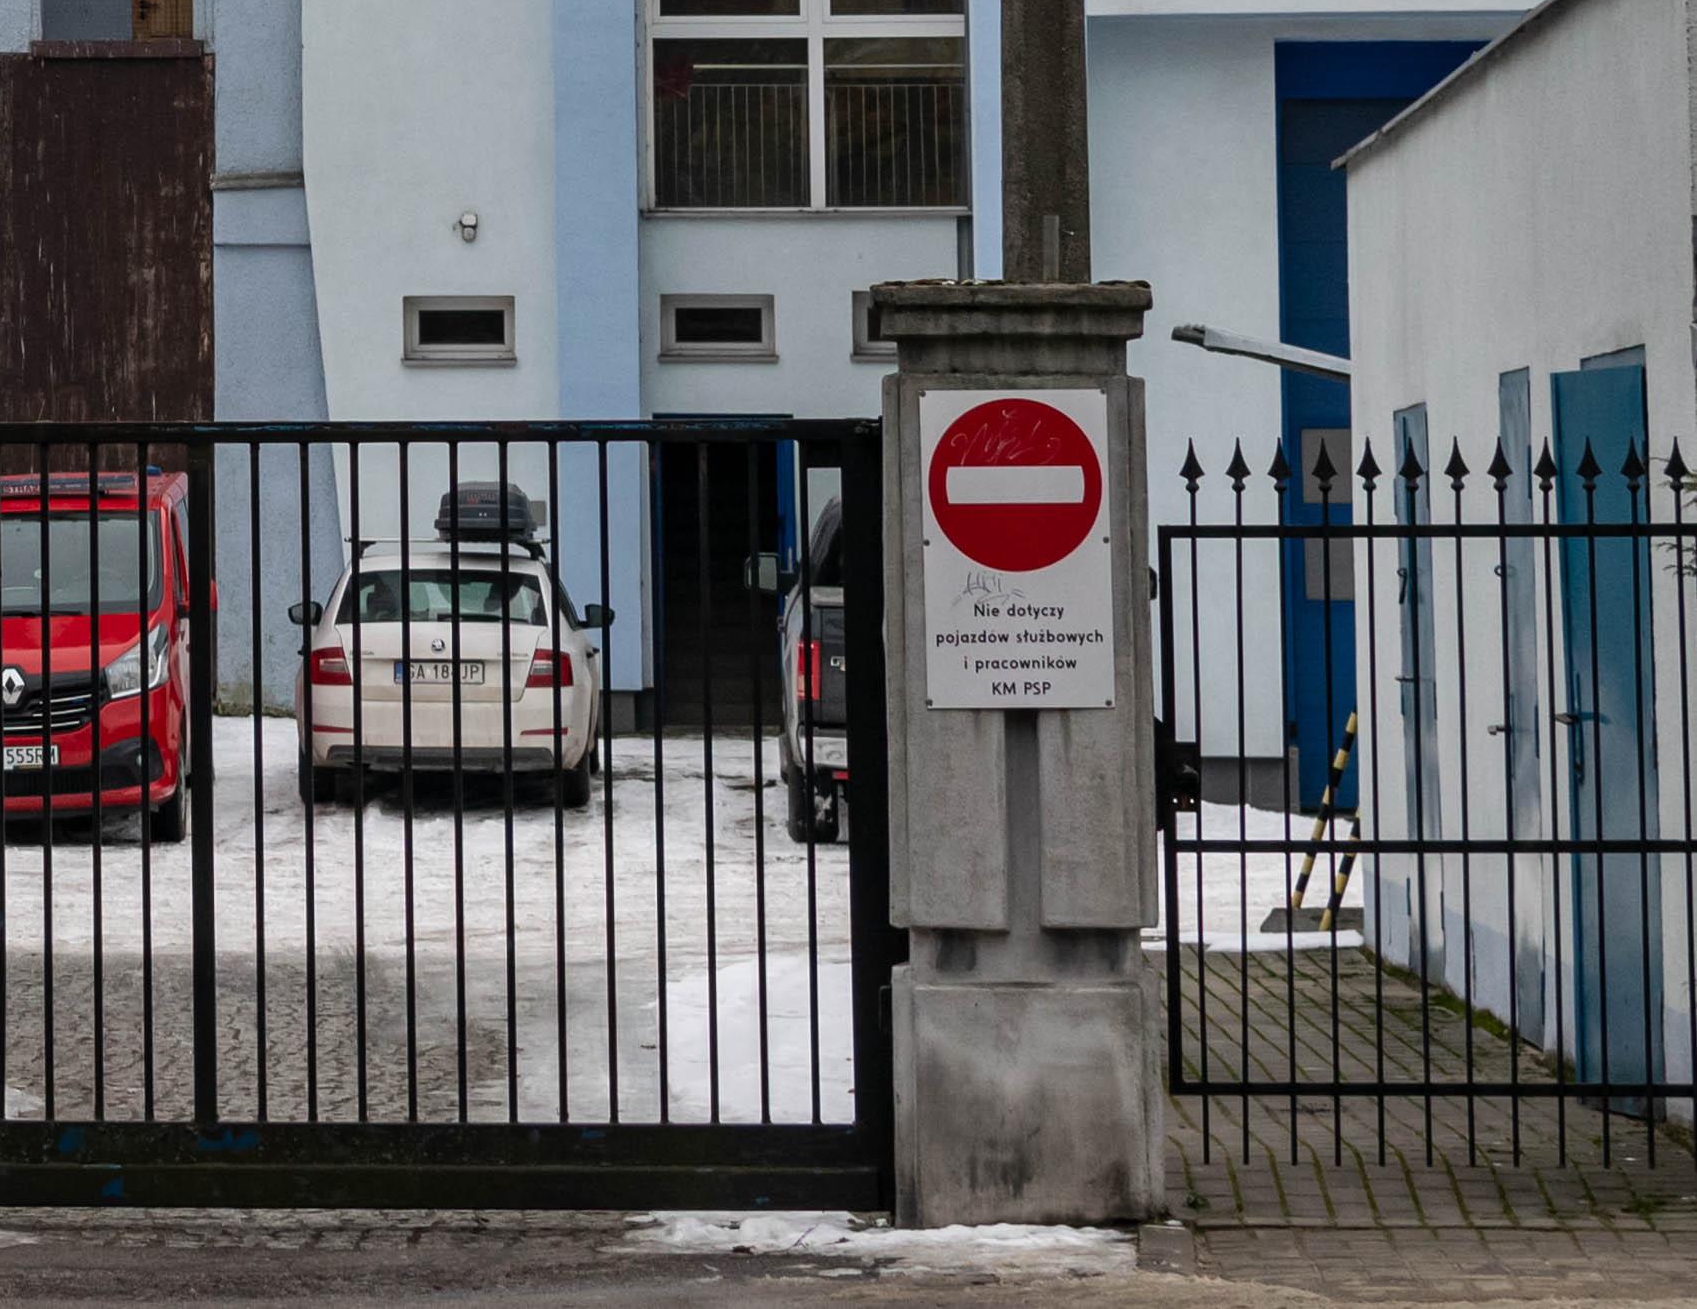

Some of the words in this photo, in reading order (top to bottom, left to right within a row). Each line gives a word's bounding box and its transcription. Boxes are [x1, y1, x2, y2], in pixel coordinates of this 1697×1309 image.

[974, 604, 1000, 617] Nie
[1007, 603, 1064, 620] dotyczy
[936, 630, 1009, 647] pojazdów
[1016, 629, 1103, 646] służbowych
[433, 664, 479, 680] 18JP
[963, 656, 968, 670] i
[975, 655, 1077, 673] pracowników
[992, 682, 1017, 695] KM
[1024, 682, 1052, 695] PSP
